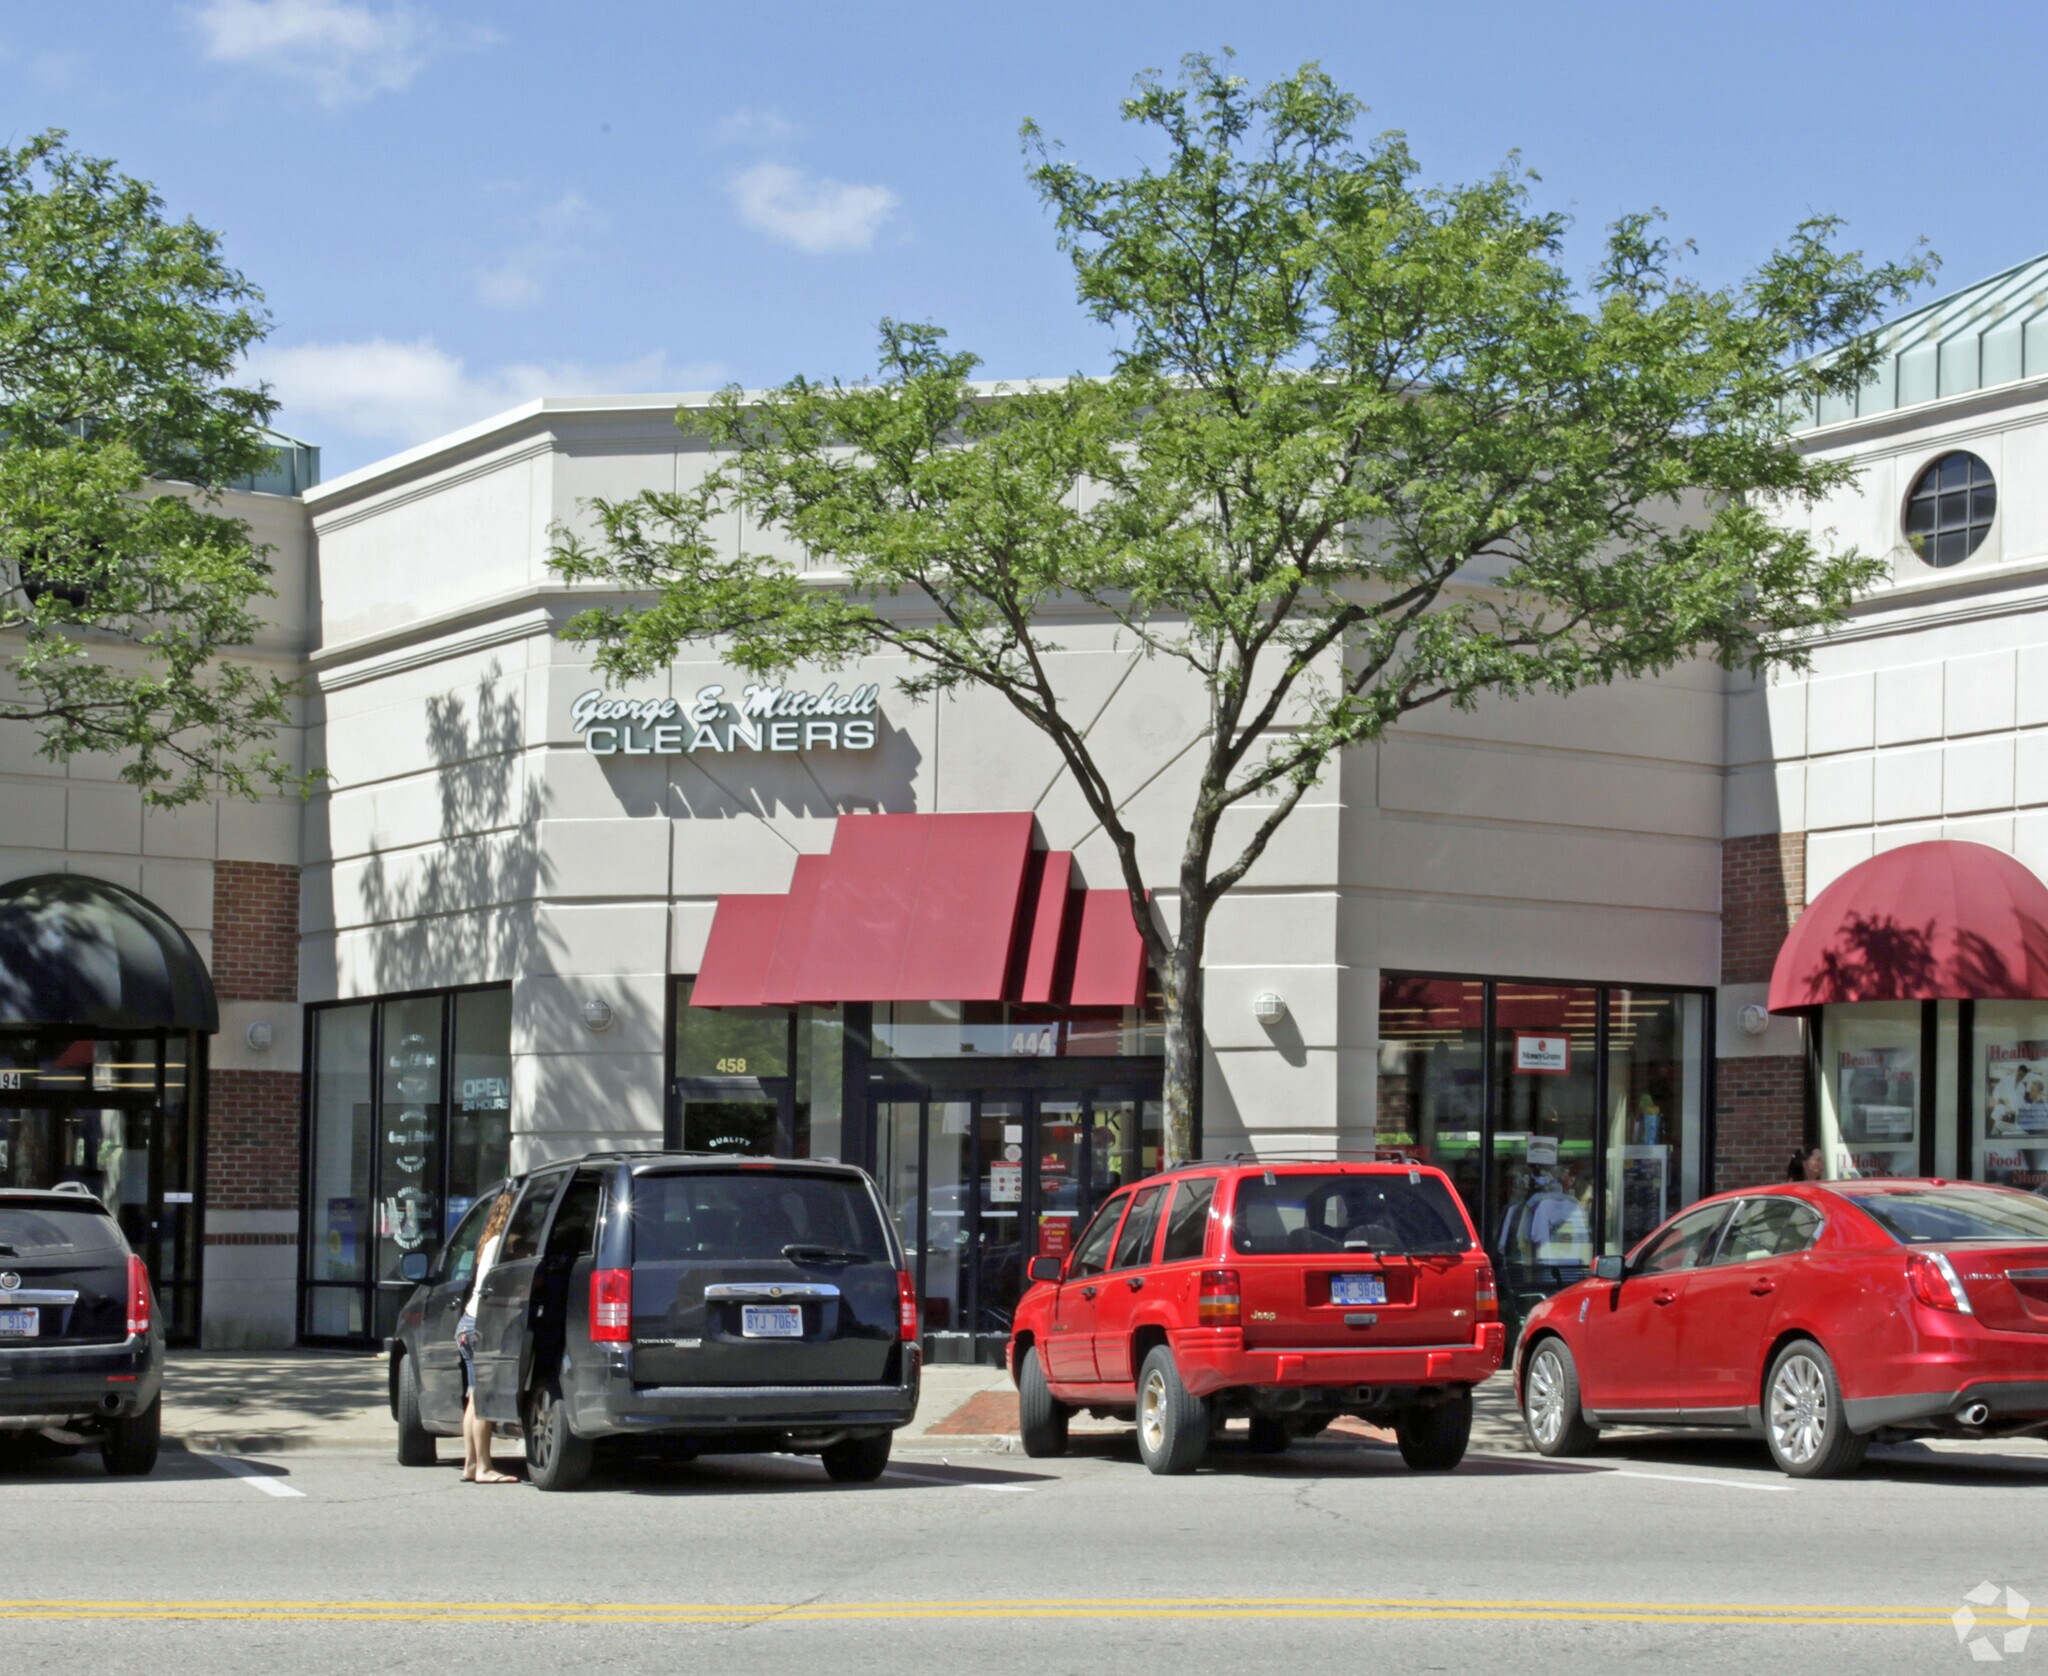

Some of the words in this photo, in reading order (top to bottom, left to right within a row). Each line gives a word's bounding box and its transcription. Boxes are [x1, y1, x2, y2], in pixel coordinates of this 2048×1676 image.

[571, 689, 677, 733] George
[692, 685, 727, 722] E.
[743, 682, 880, 719] Mitchell
[585, 721, 877, 754] CLEANERS
[1012, 1032, 1051, 1054] 444
[716, 1057, 747, 1073] 458
[463, 1077, 509, 1098] OPEN
[463, 1100, 475, 1111] 24
[476, 1098, 509, 1110] HOURS
[709, 1136, 751, 1147] QUALITY
[1989, 1151, 2023, 1168] Food
[9, 1315, 34, 1329] 9167
[772, 1315, 798, 1329] 7065
[1250, 1310, 1276, 1322] Jeep
